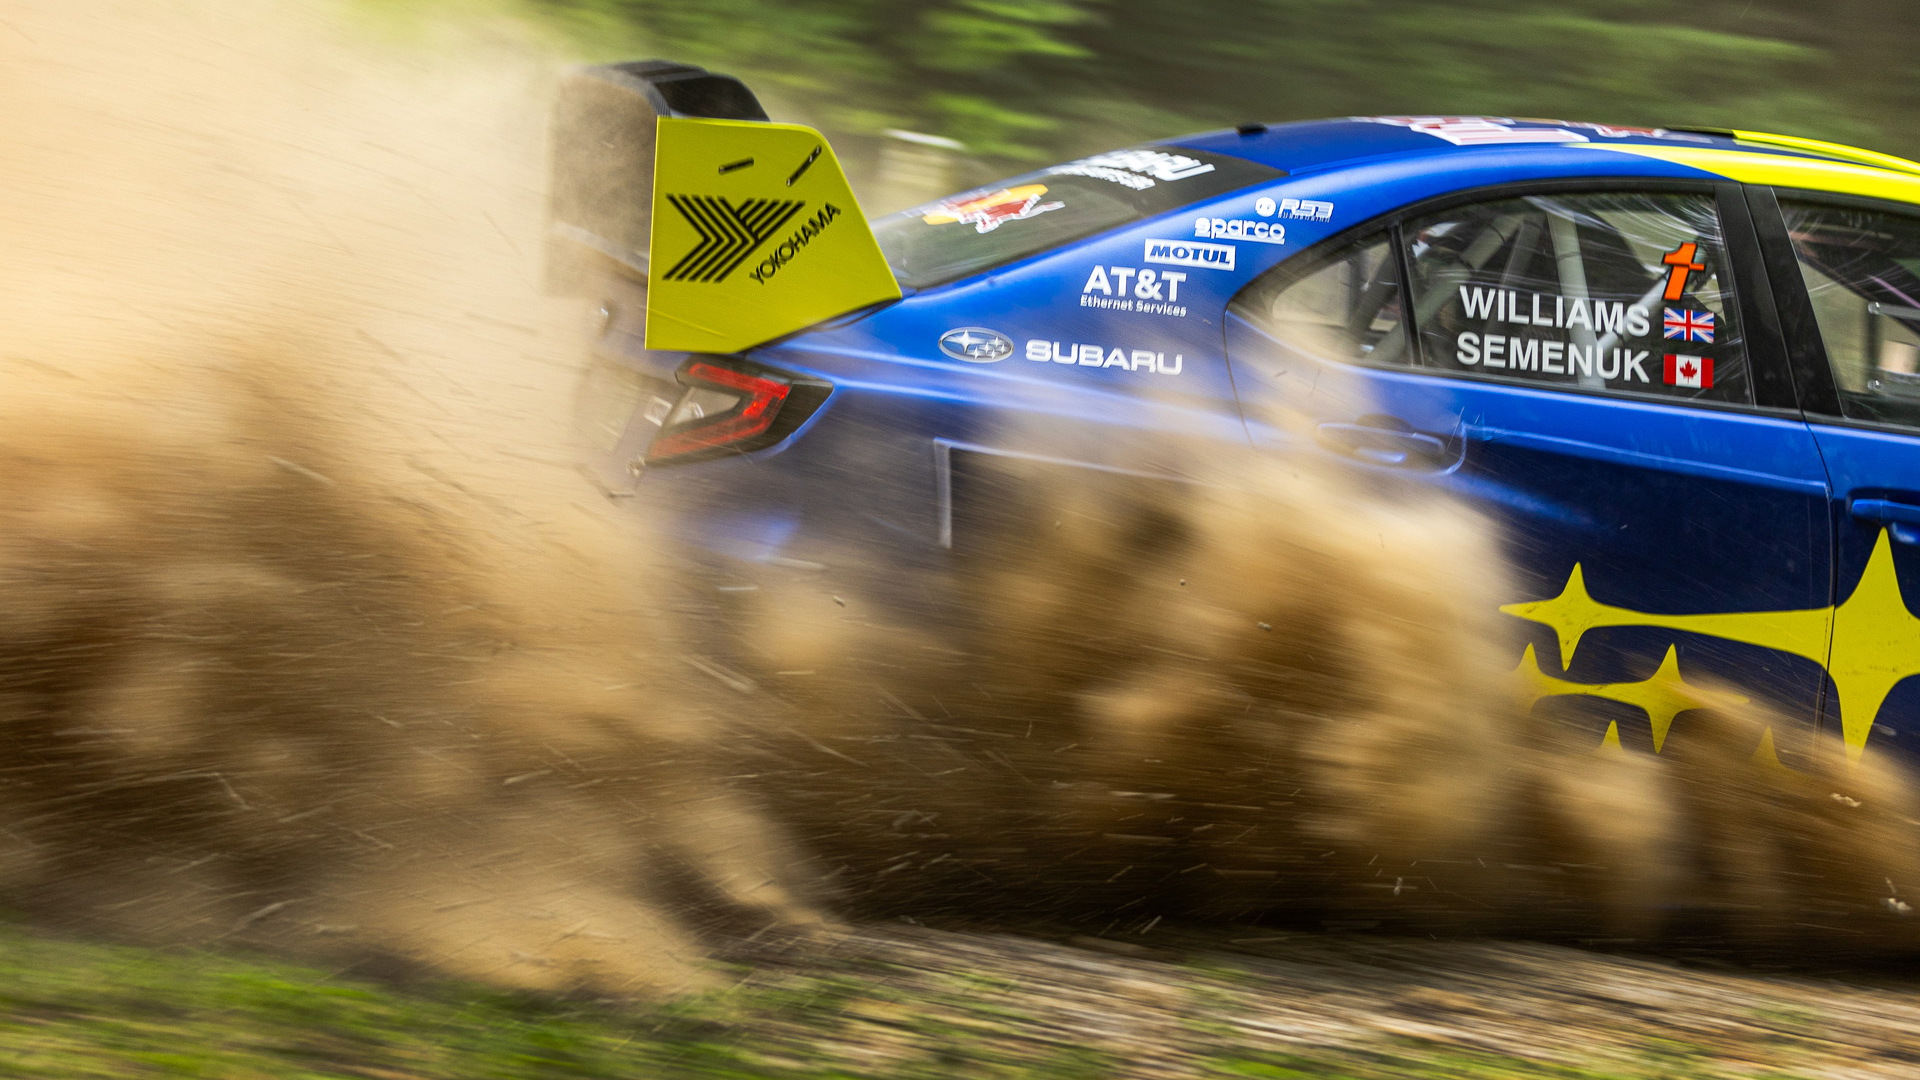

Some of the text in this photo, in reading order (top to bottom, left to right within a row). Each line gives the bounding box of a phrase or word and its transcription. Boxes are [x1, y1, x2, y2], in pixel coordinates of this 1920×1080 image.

[749, 202, 841, 286] YOKOHAMA
[1194, 217, 1286, 244] sparco
[1150, 244, 1231, 265] MOTUL
[1661, 241, 1707, 302] 1
[1083, 265, 1187, 302] AT&T
[1080, 294, 1187, 317] Ethernet Services
[1459, 285, 1650, 337] WILLIAMS
[1026, 339, 1183, 376] SUBARU
[1456, 331, 1650, 384] SEMENUK
